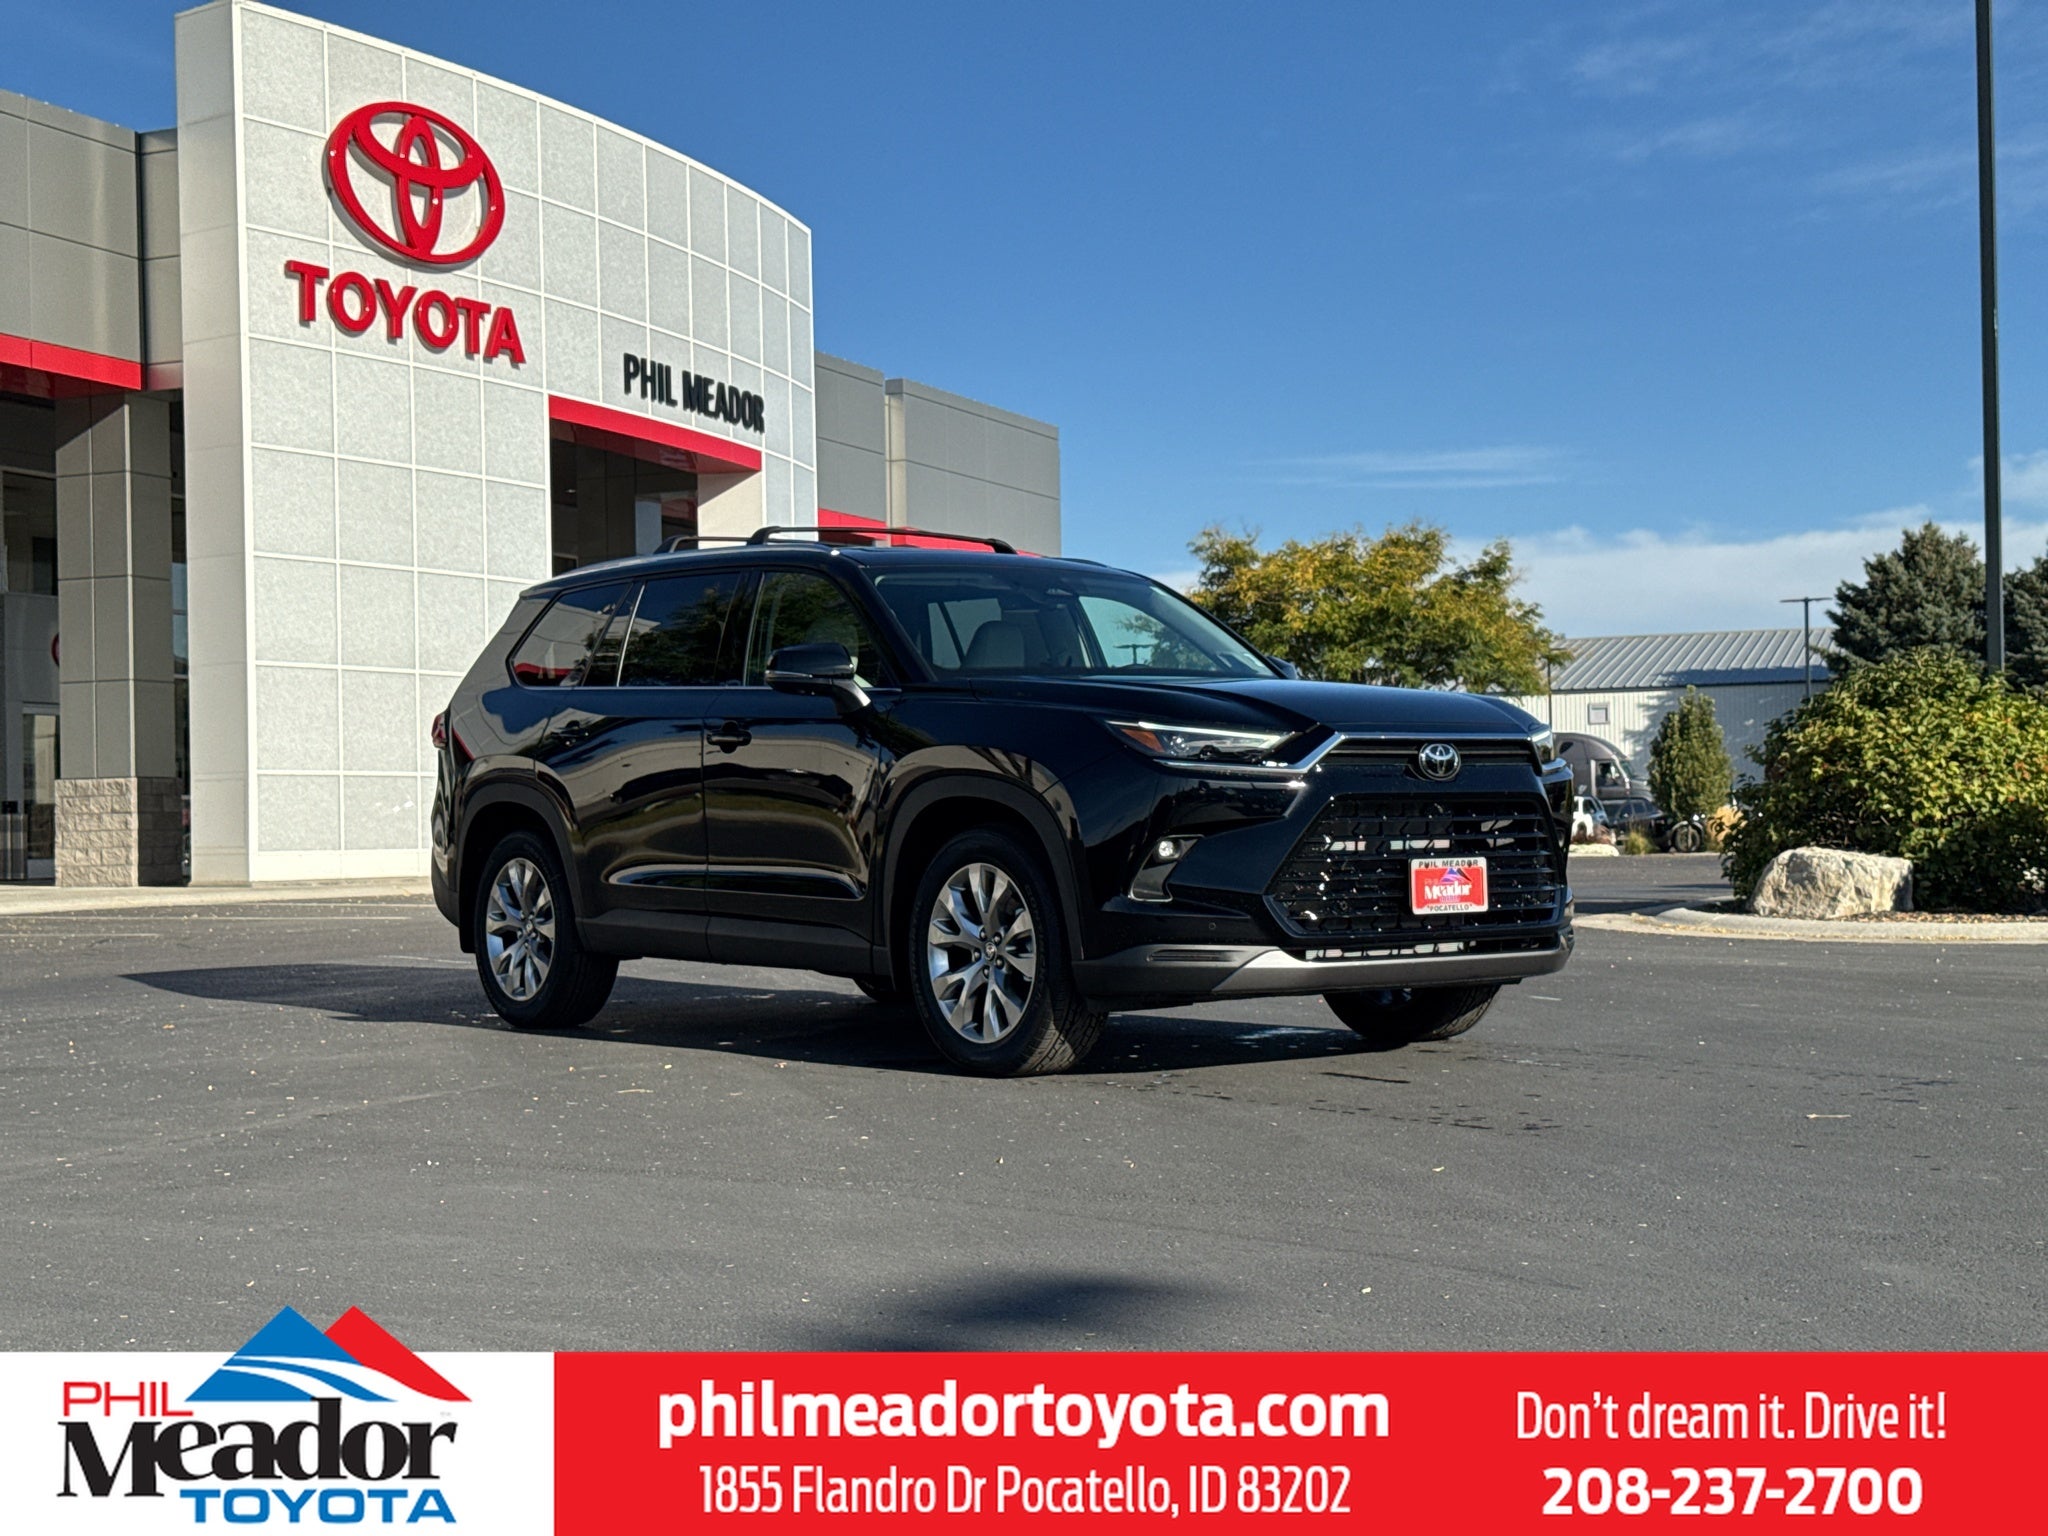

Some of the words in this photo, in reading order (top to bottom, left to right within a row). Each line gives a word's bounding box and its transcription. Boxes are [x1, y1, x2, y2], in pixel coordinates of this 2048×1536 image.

[286, 260, 526, 364] TOYOTA
[623, 353, 677, 407] PHIL
[682, 371, 765, 432] MEADOR
[1424, 881, 1472, 900] Meador
